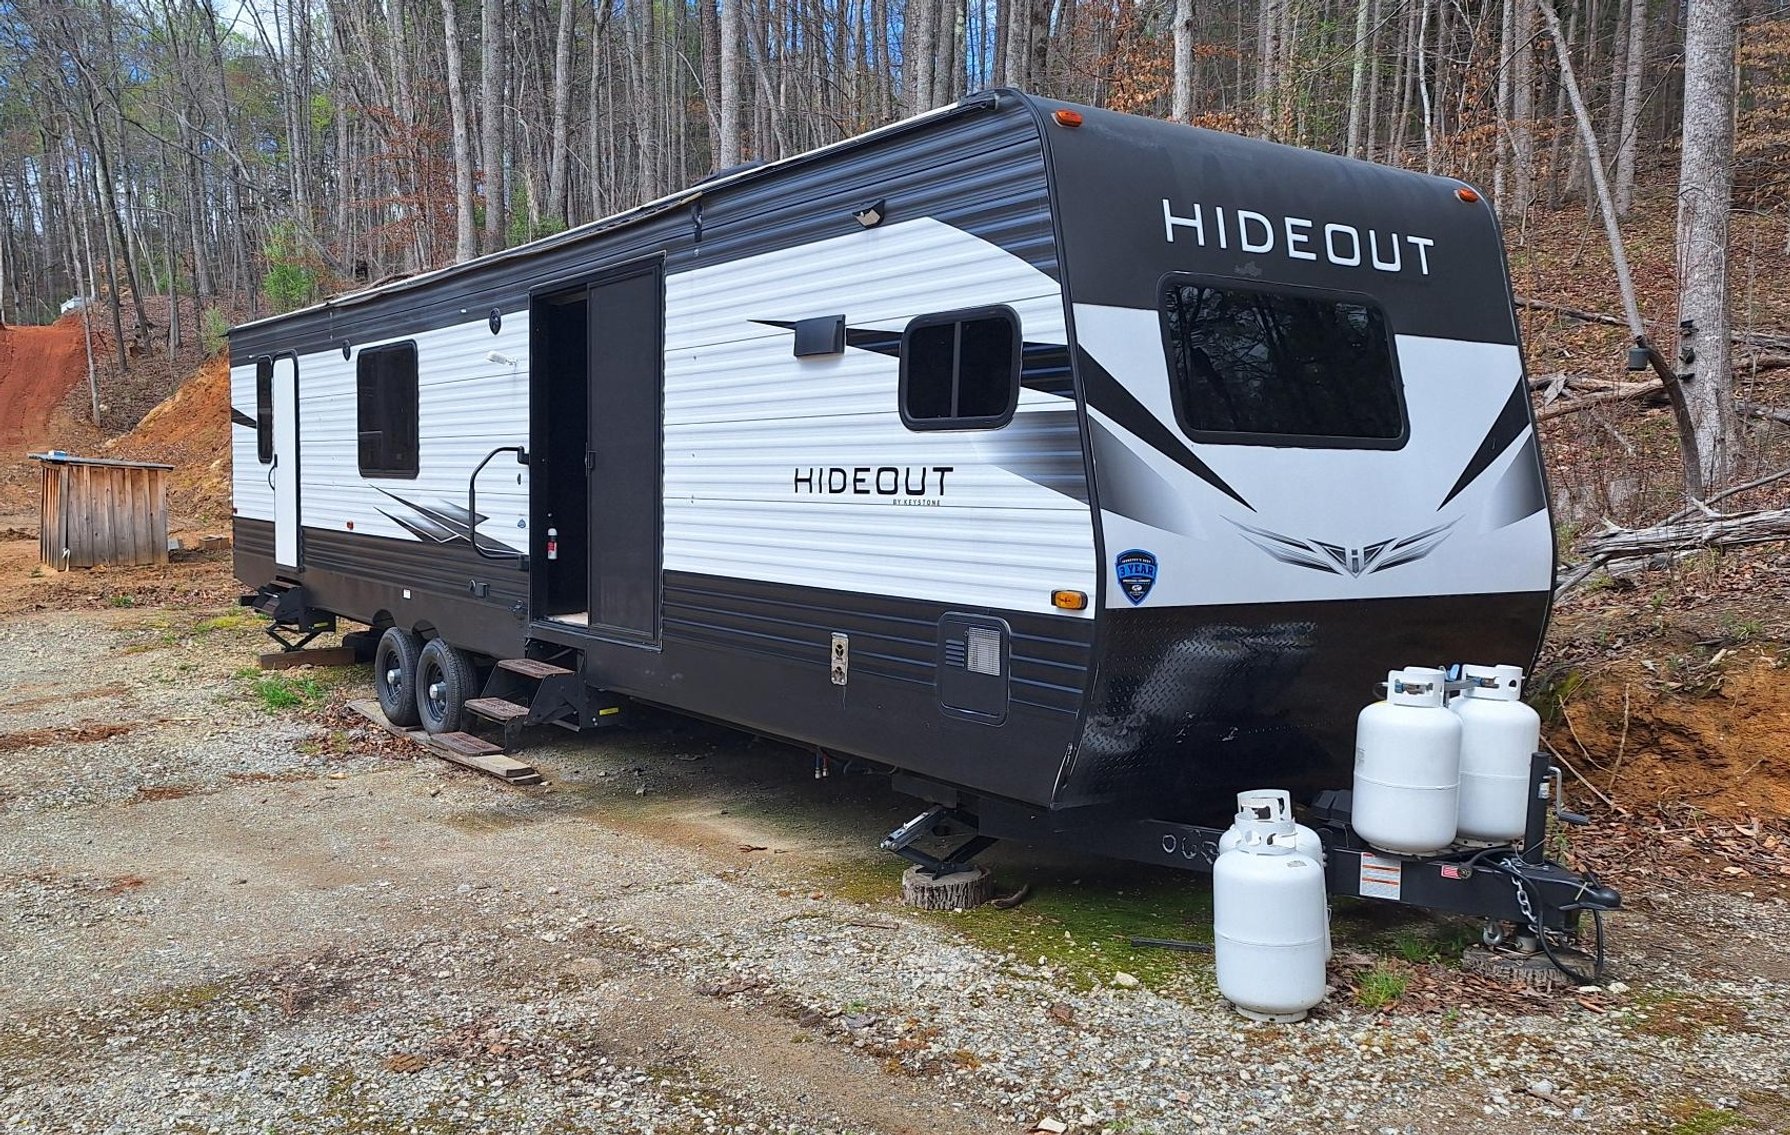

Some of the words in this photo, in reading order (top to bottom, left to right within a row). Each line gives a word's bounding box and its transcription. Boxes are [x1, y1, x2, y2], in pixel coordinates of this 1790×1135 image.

[1162, 198, 1434, 275] HIDEOUT
[795, 466, 954, 496] HIDEOUT
[904, 499, 941, 507] KEYSTONE
[1119, 565, 1126, 577] 3
[1128, 564, 1154, 577] YEAR
